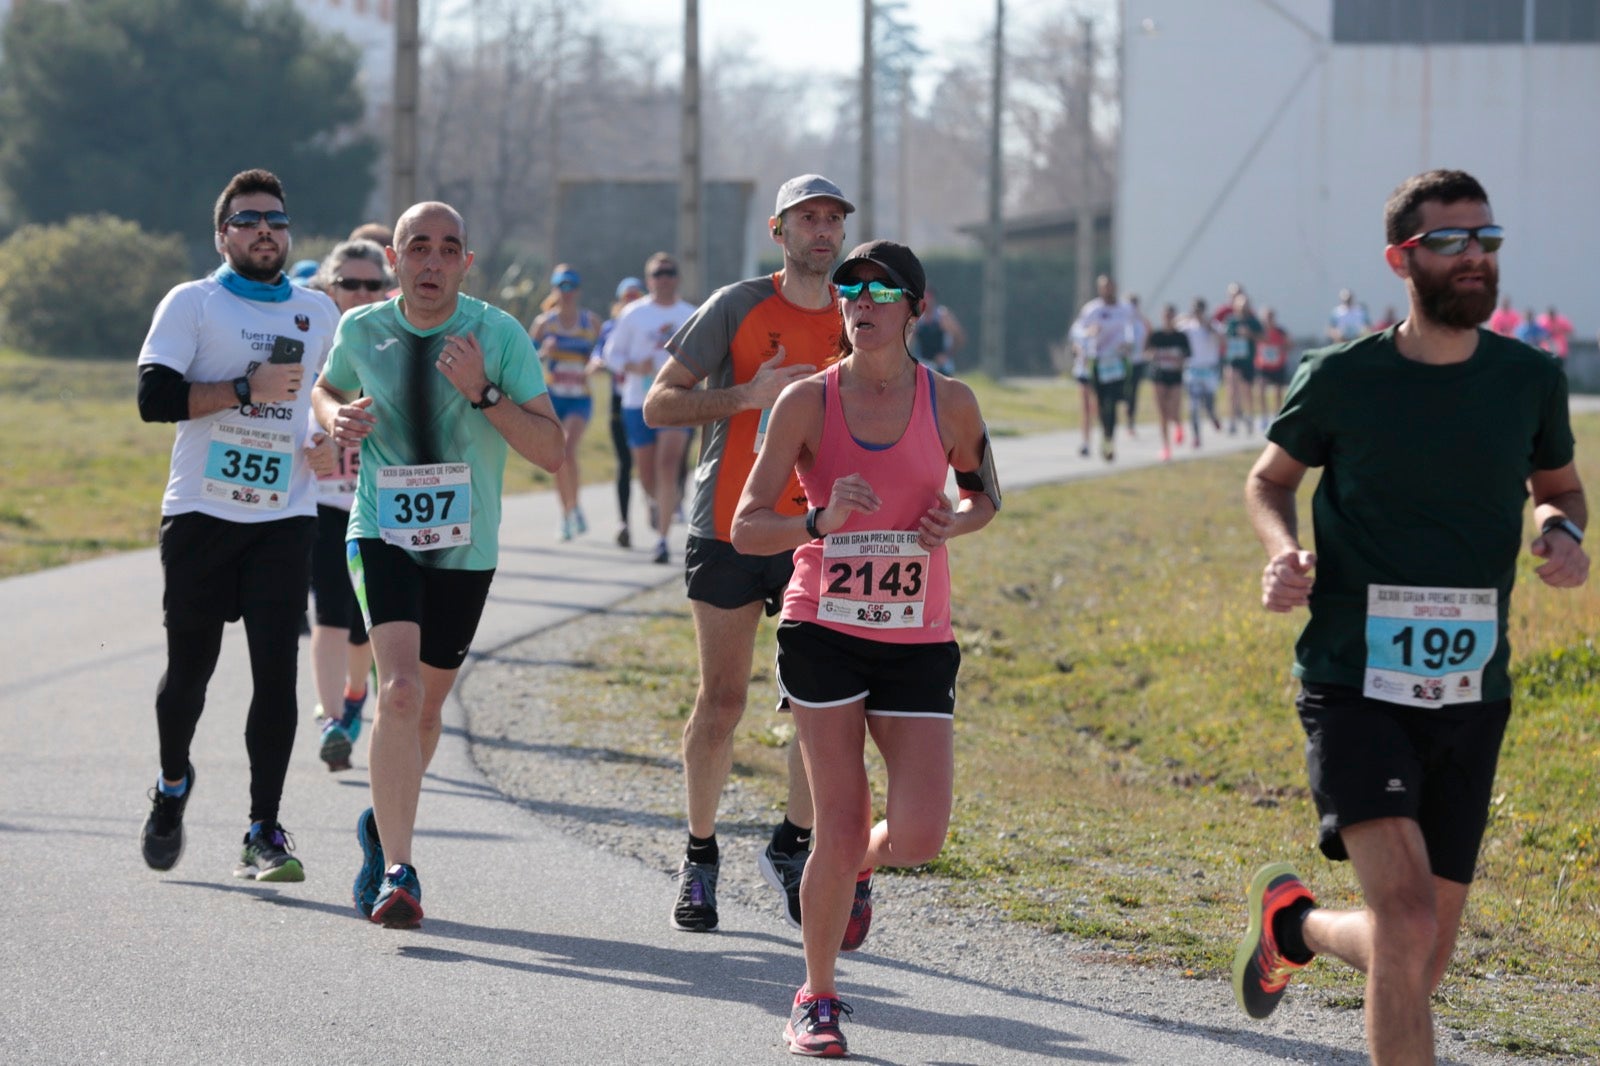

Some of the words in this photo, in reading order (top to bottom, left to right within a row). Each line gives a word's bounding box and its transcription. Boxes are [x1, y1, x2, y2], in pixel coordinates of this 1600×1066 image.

[222, 450, 280, 484] 355
[399, 468, 412, 477] GRAN
[414, 467, 435, 476] PREMIO
[437, 466, 443, 475] DE
[445, 465, 464, 474] FONDO
[394, 490, 456, 524] 397
[832, 535, 850, 545] XXXIII
[851, 535, 869, 544] GRAN
[870, 534, 895, 543] PREMIO
[897, 534, 905, 543] DE
[860, 544, 900, 554] DIPUTACIÓN
[827, 561, 922, 596] 2143
[1392, 626, 1476, 670] 199
